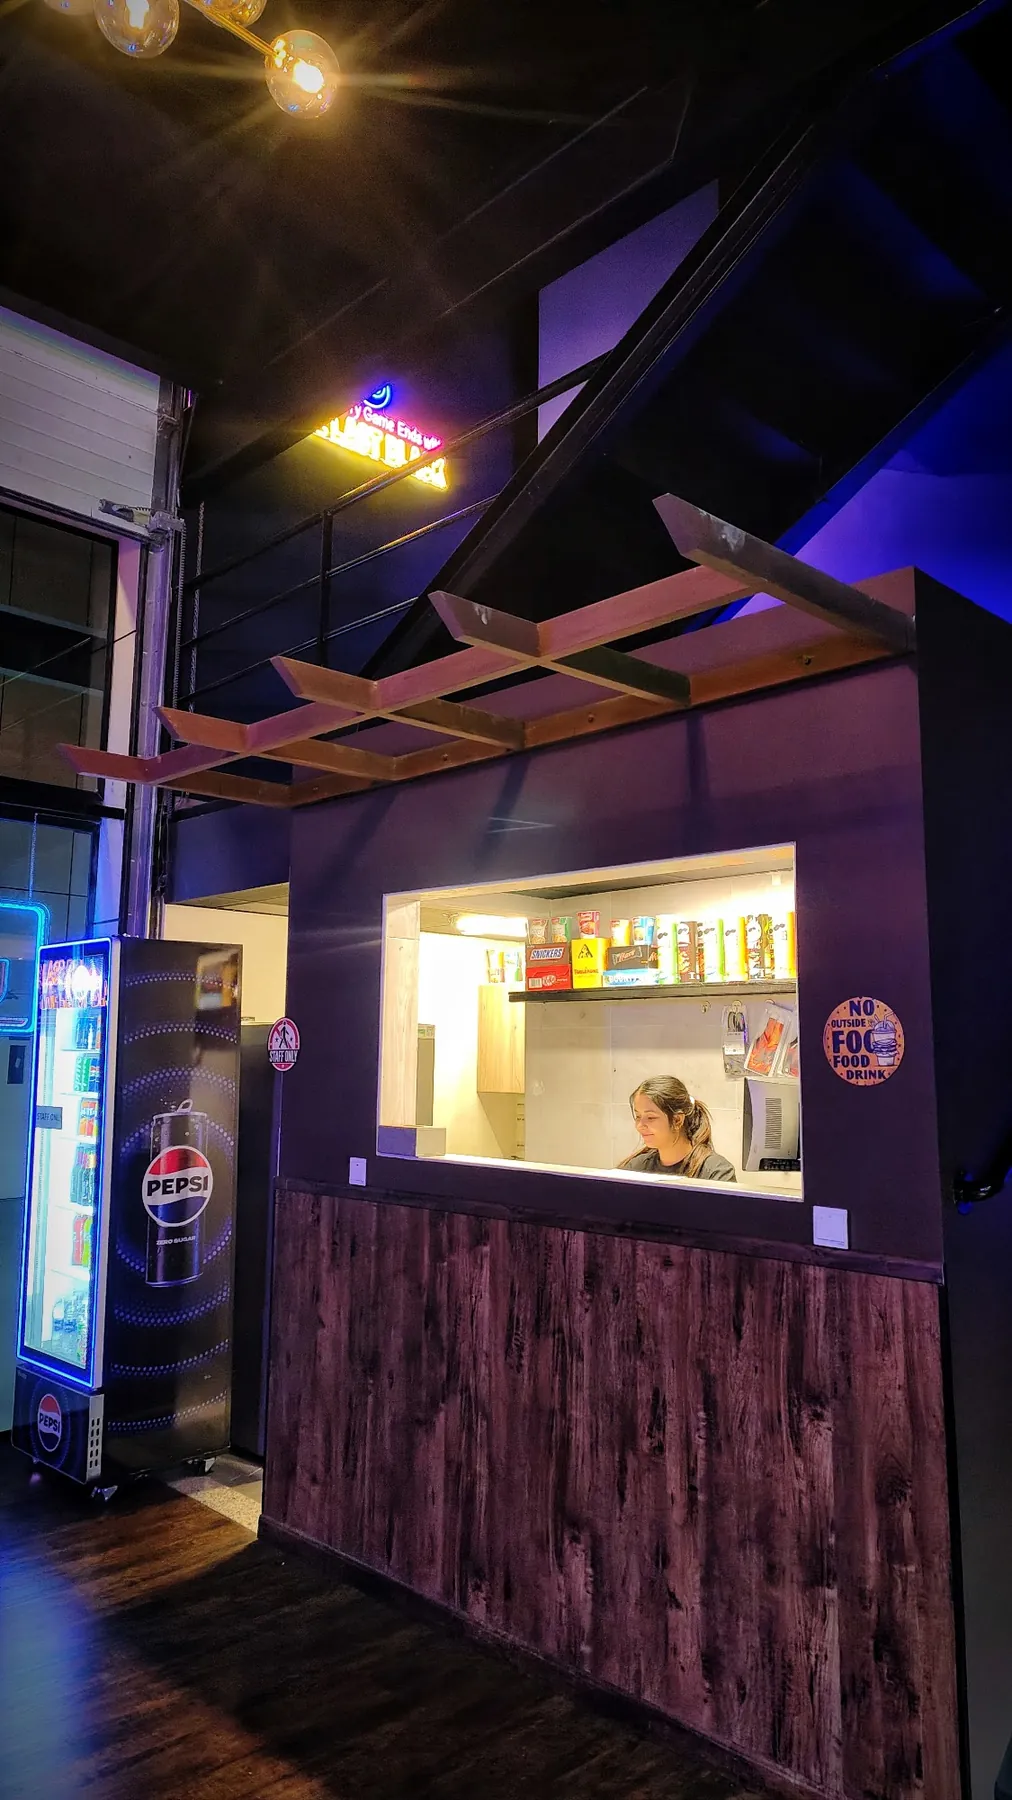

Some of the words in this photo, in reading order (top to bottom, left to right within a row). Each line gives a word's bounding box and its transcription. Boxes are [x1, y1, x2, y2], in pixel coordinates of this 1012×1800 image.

[362, 406, 395, 432] Game
[397, 421, 423, 446] Ends
[531, 948, 563, 959] SNICKERS
[849, 999, 875, 1017] NO
[831, 1019, 866, 1028] OUTSIDE
[270, 1050, 285, 1062] STAFF
[285, 1050, 298, 1062] ONLY
[833, 1054, 870, 1068] FOOD
[846, 1069, 887, 1080] DRINK
[146, 1175, 209, 1196] PEPSI
[173, 1235, 196, 1244] SUGAR
[39, 1413, 60, 1434] PEPSI
